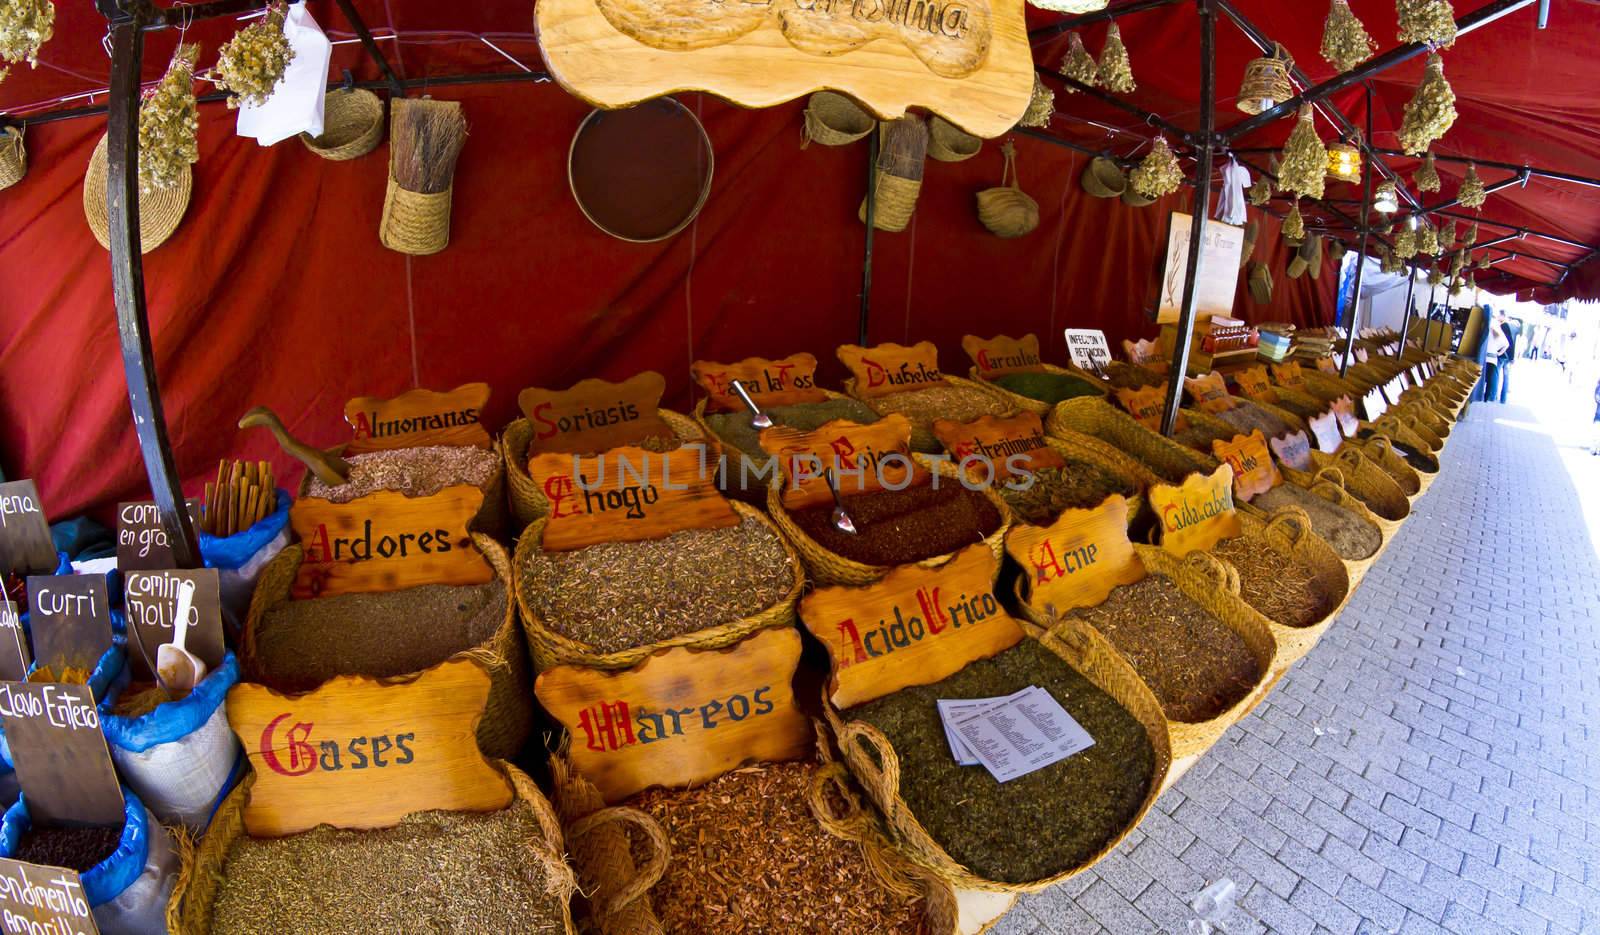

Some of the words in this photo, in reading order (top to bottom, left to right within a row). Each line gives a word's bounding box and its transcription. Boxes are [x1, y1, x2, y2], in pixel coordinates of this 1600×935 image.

[704, 372, 761, 395] Para
[861, 357, 943, 388] Diabetes
[354, 408, 479, 442] Almorranas
[532, 400, 640, 440] Soriasis
[544, 474, 659, 519] Ahogo
[120, 529, 135, 546] en
[304, 520, 451, 563] Ardores
[1028, 538, 1098, 586] Acne
[38, 588, 97, 617] Curri
[836, 605, 924, 668] Acido
[43, 686, 98, 730] Entero
[577, 685, 774, 752] Mareos
[260, 713, 415, 777] Gases
[0, 865, 89, 918] ondimento
[3, 909, 86, 935] Amarill
